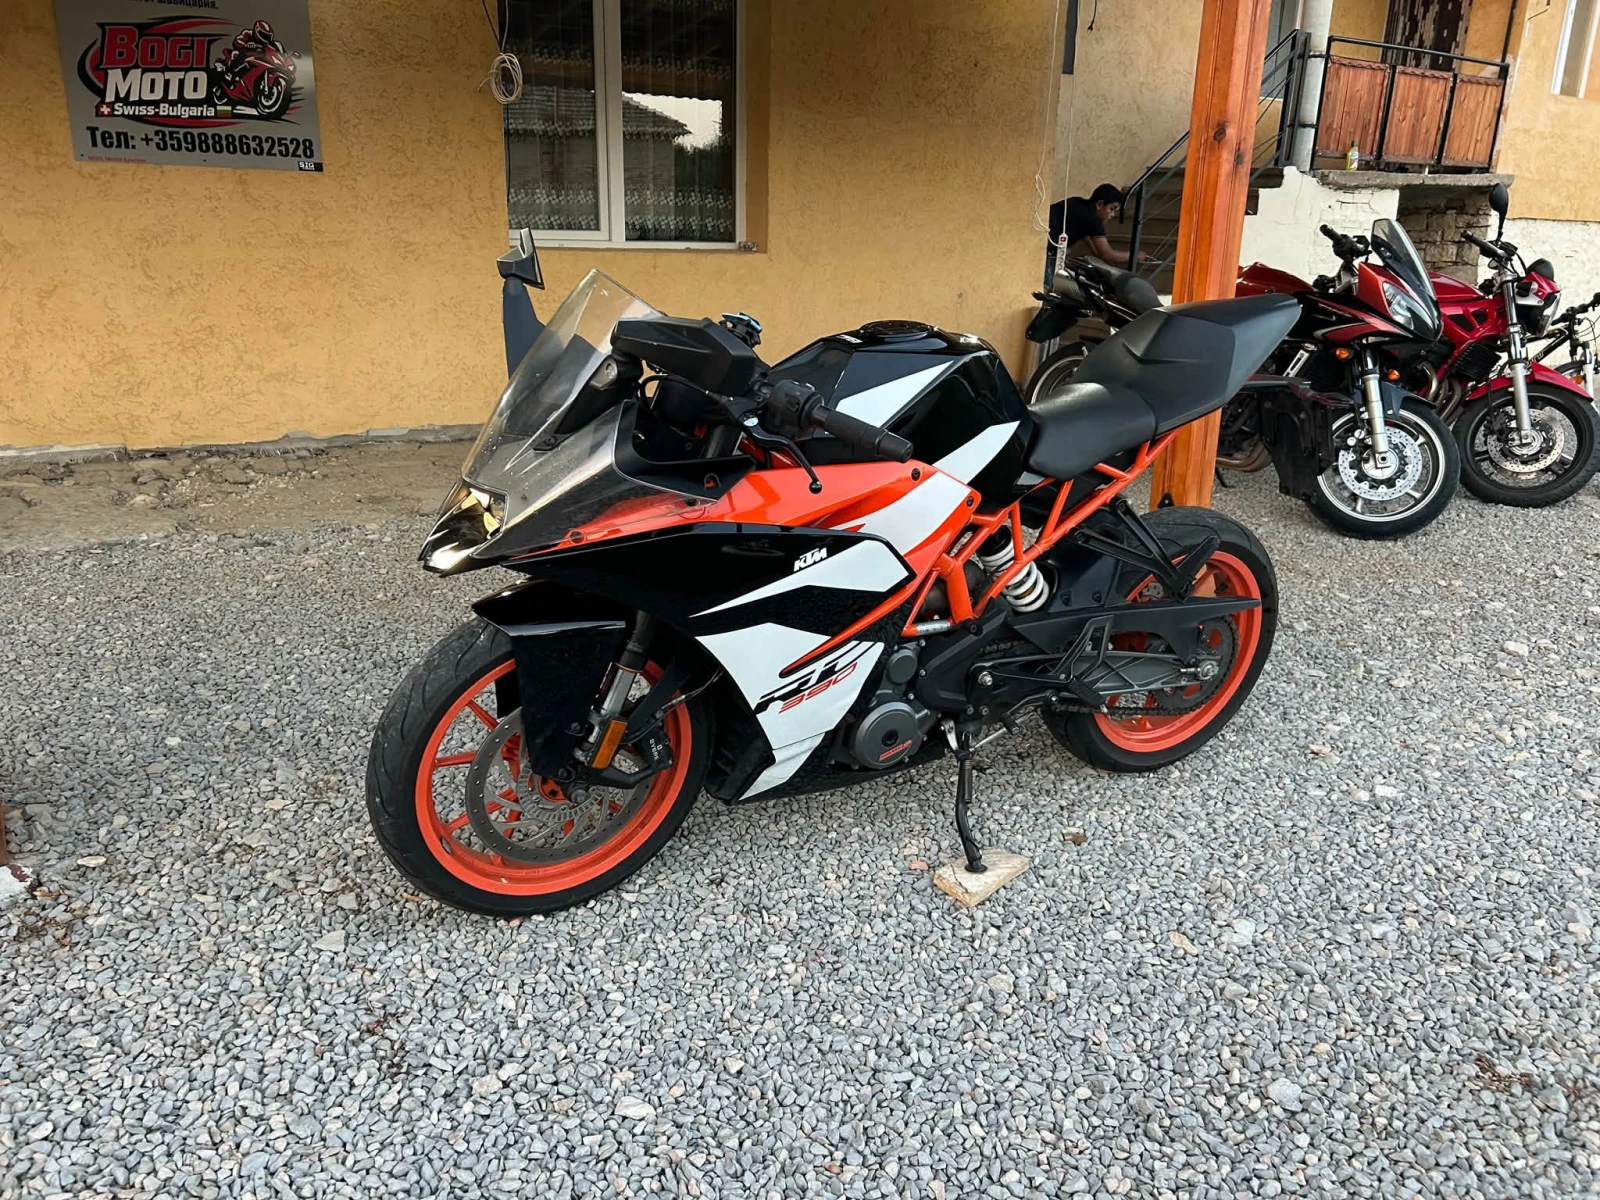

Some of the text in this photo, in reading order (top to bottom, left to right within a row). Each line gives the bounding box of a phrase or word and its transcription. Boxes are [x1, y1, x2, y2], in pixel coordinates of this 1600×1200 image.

[103, 25, 208, 68] BOGI
[105, 68, 207, 102] MOTO
[113, 103, 215, 118] Swiss-Bulgaria
[86, 126, 314, 159] Тел: +359888632528
[793, 547, 828, 572] KTM
[779, 661, 858, 714] 390
